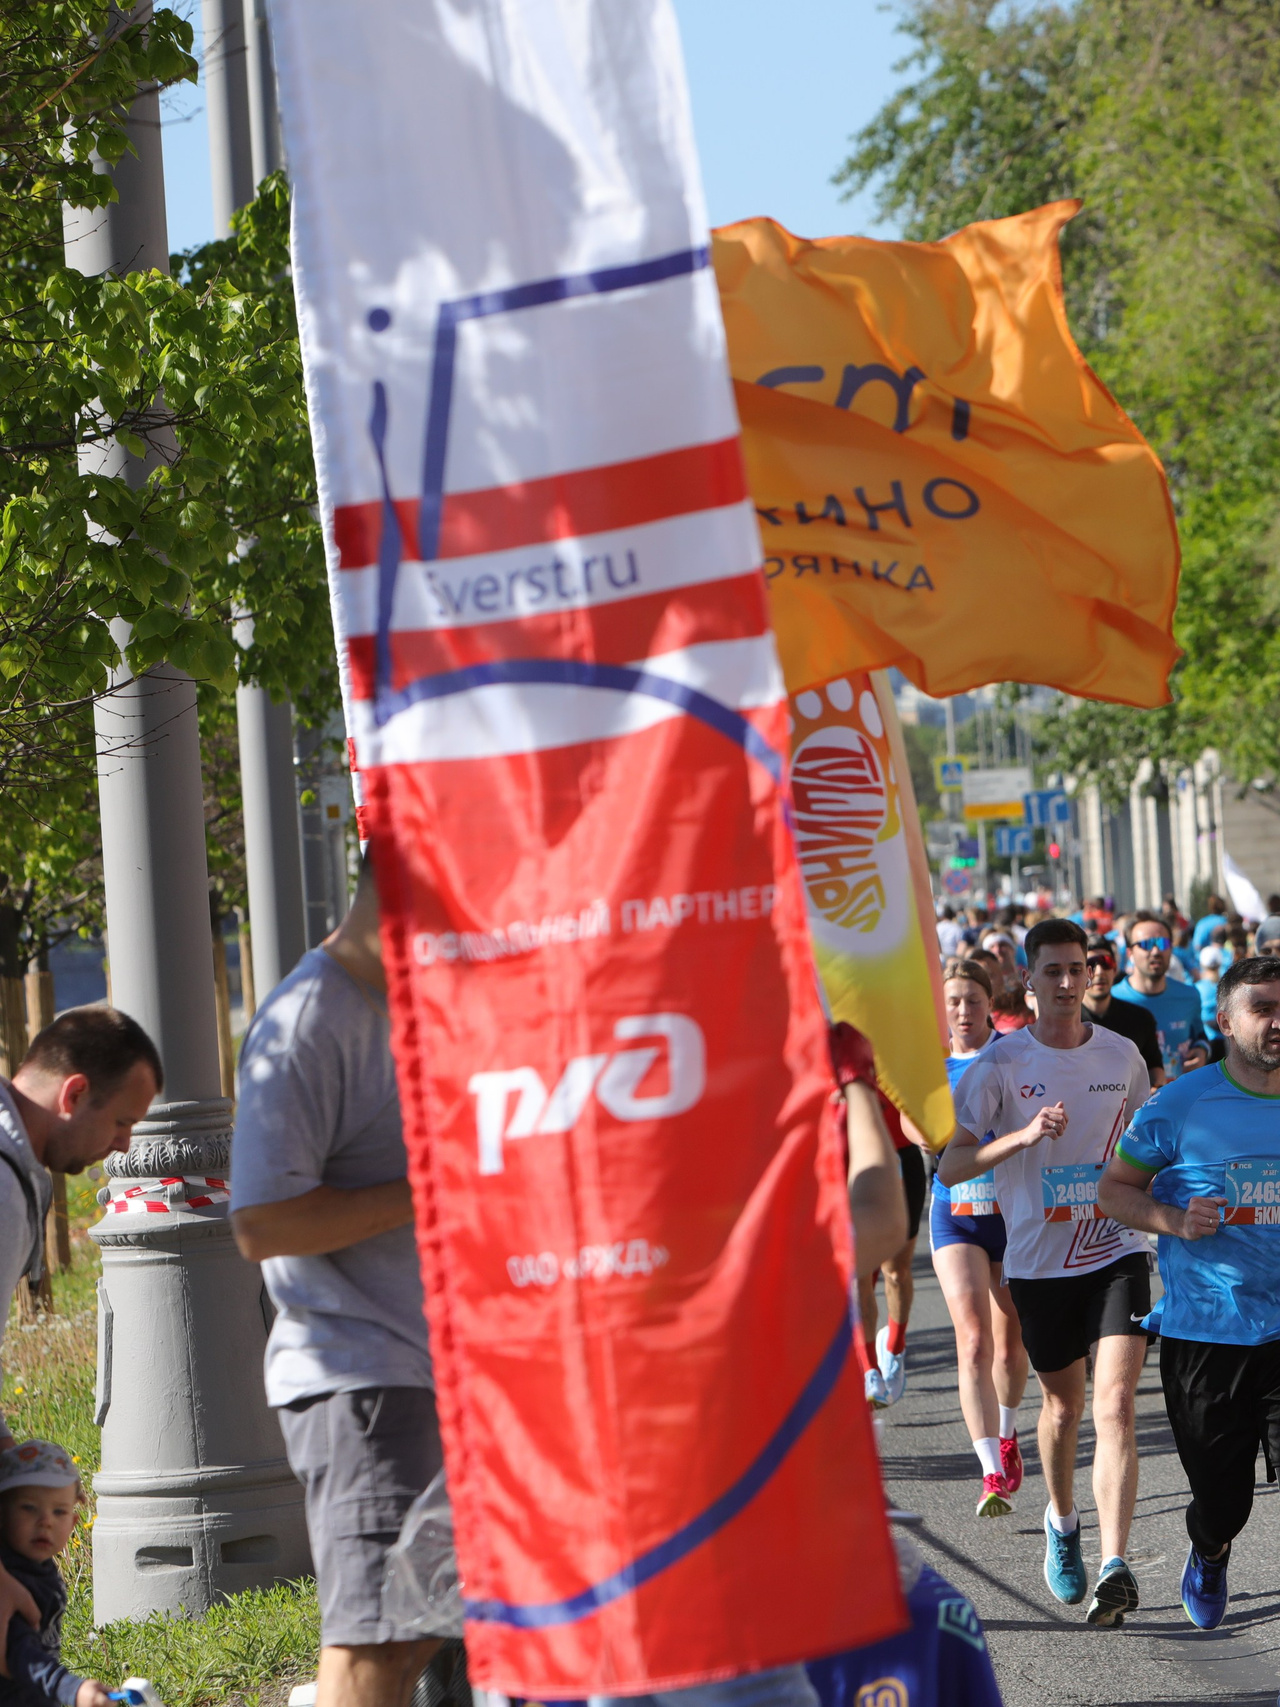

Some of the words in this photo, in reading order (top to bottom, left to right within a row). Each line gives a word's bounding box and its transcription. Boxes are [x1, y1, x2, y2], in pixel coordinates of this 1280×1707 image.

[620, 883, 783, 934] ПАРТНЕР
[960, 1182, 996, 1201] 2405
[972, 1201, 994, 1215] 5KM
[1070, 1204, 1095, 1221] 5KM
[1254, 1206, 1280, 1225] 5KM
